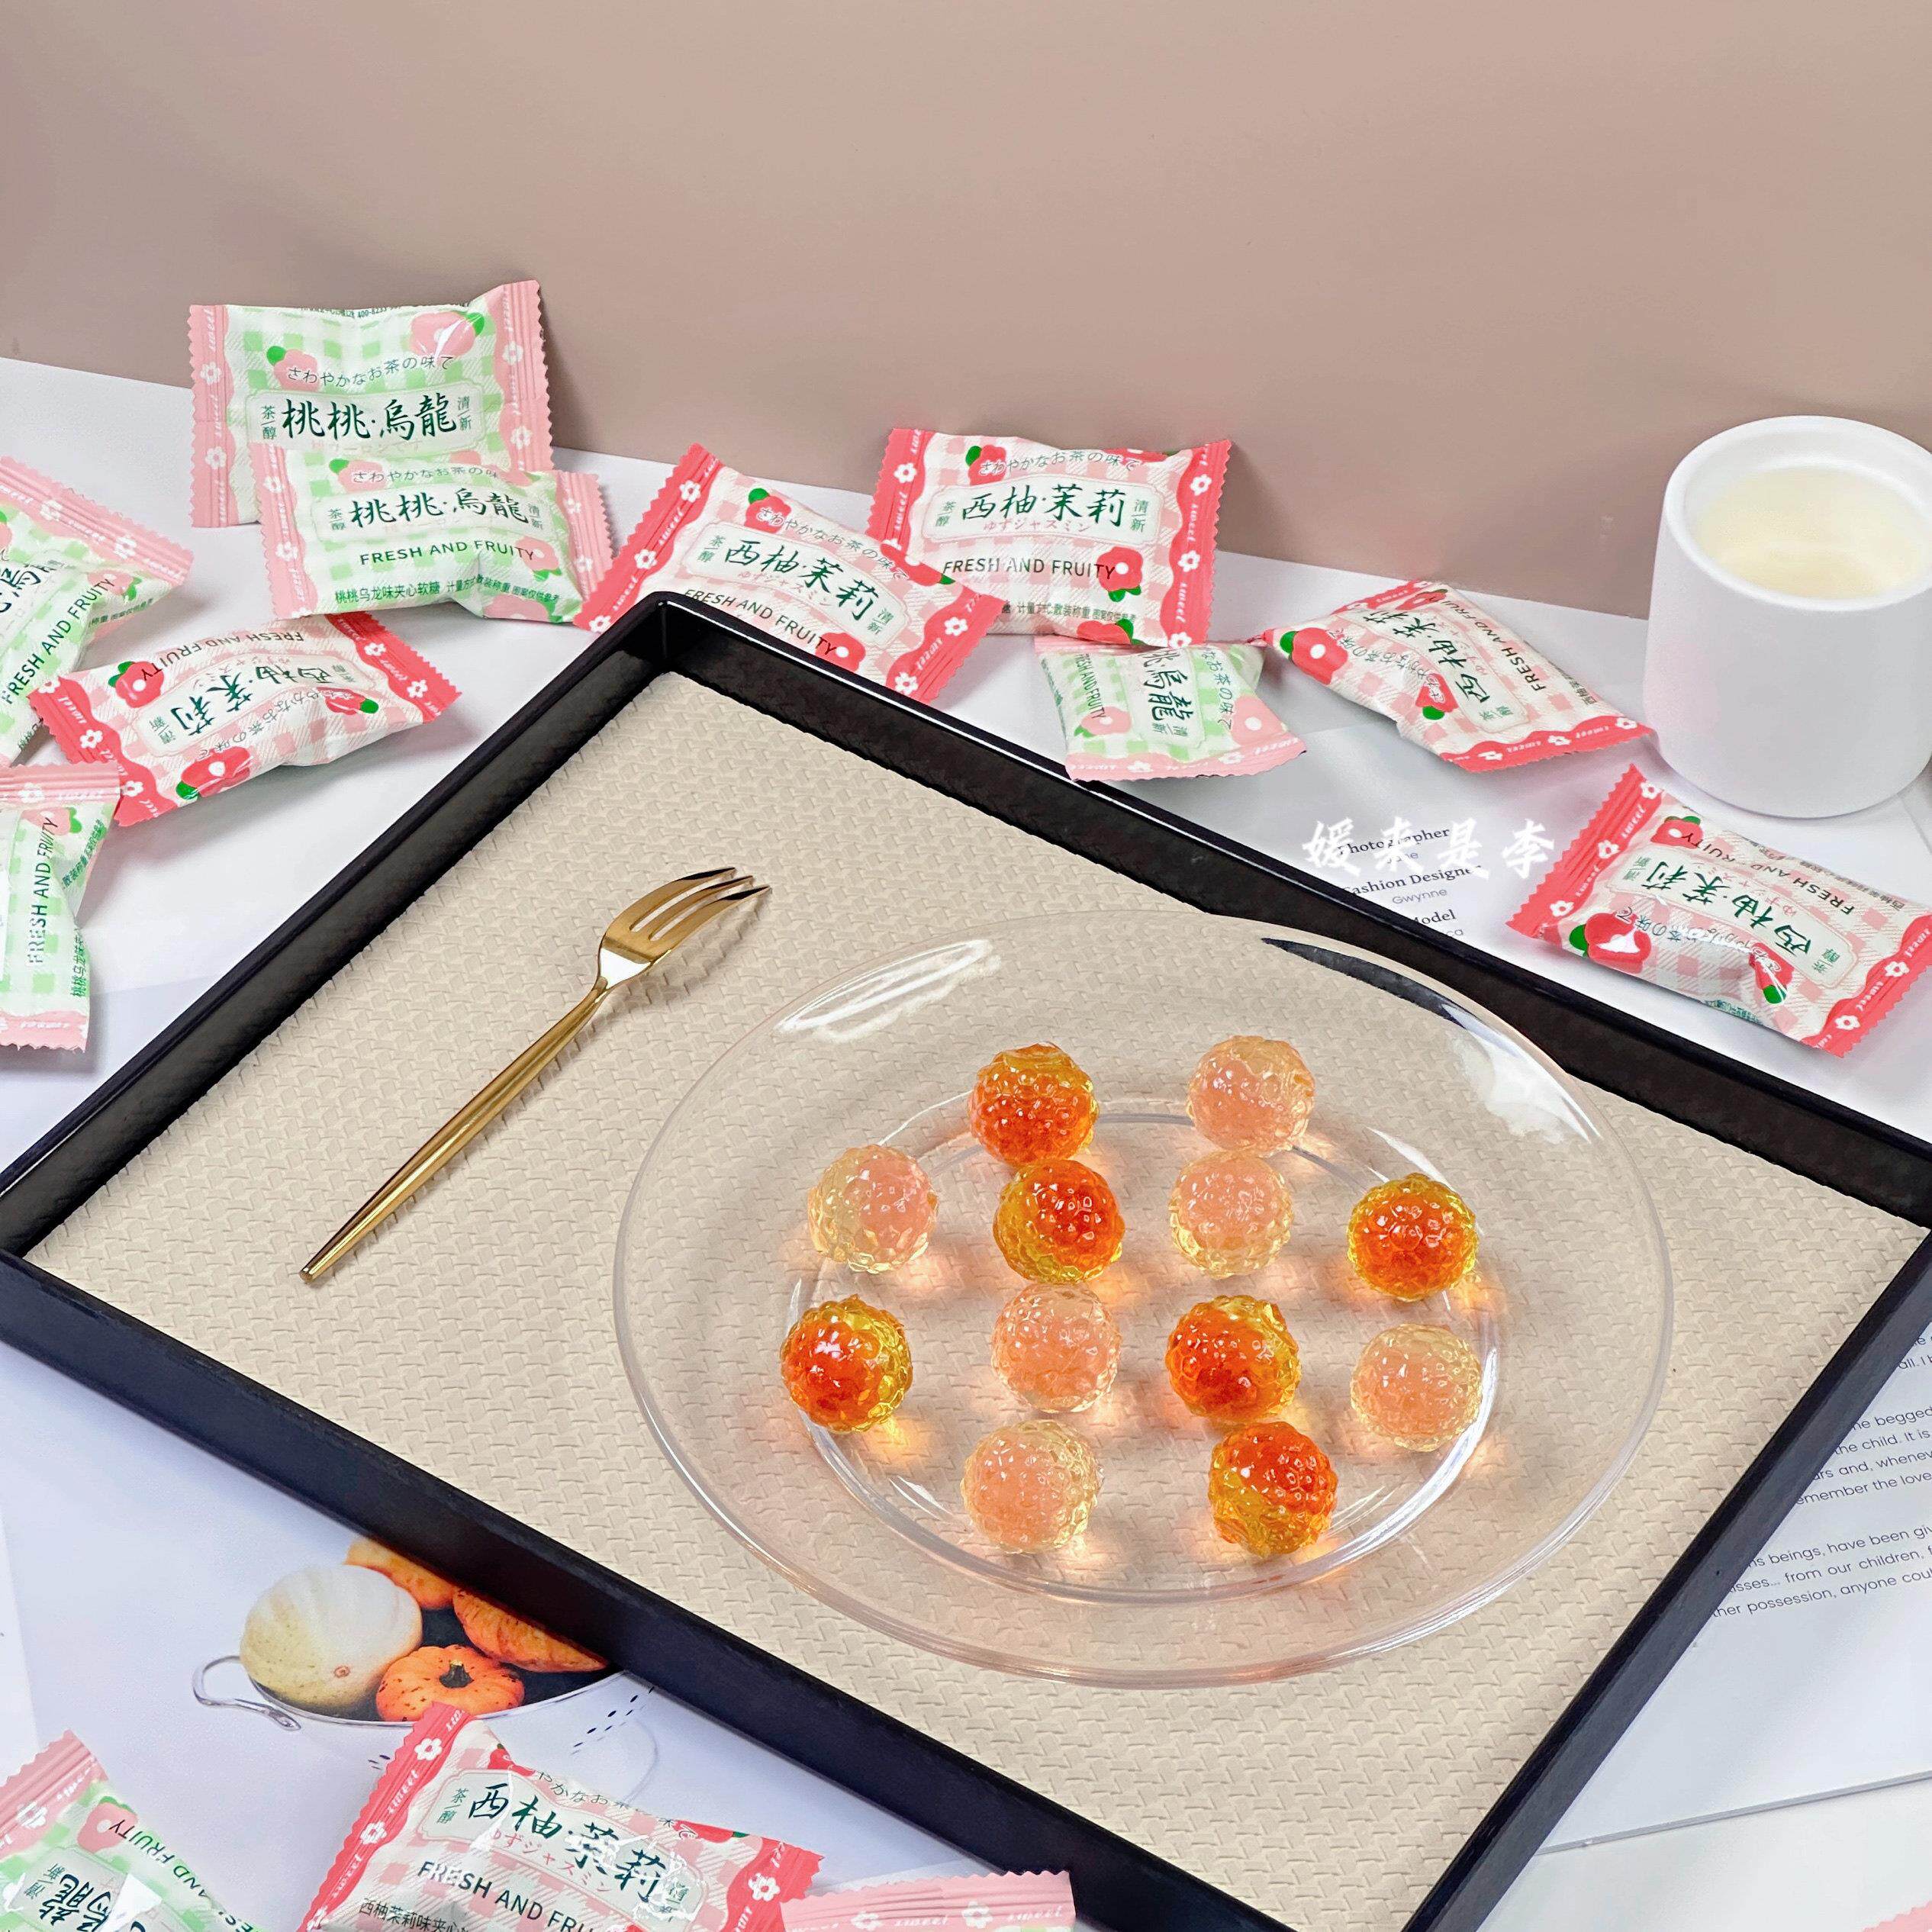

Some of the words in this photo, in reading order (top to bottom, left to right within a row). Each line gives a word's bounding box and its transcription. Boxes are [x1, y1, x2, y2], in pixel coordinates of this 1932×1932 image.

[658, 507, 685, 546] sweet
[359, 546, 423, 565] FRESH
[429, 541, 468, 555] AND
[475, 540, 534, 561] FRUITY
[942, 557, 1000, 575] FRESH
[1006, 558, 1045, 573] AND
[1051, 560, 1117, 581] FRUITY
[249, 631, 305, 642] FRESH
[685, 589, 738, 607] FRESH
[736, 599, 778, 620] AND
[774, 614, 837, 655] FRUITY
[1474, 620, 1507, 644] AND
[2, 653, 45, 705] FRESH
[40, 620, 72, 656] AND
[67, 577, 115, 622] FRUITY
[206, 636, 241, 649] AND
[140, 642, 202, 683] FRUITY
[1500, 647, 1547, 692] FRESH
[1080, 671, 1096, 691] AND
[57, 696, 88, 724] sweet
[1084, 688, 1107, 720] FRUITY
[36, 816, 59, 859] FRUITY
[1621, 803, 1646, 839] sweet
[1682, 832, 1740, 864] RUITY
[33, 858, 51, 899] AND
[1750, 863, 1792, 878] AND
[1392, 887, 1448, 905] Gwynne
[1792, 877, 1855, 916] FRESH
[27, 903, 47, 964] FRESH
[1862, 1435, 1902, 1450] child.
[1904, 1431, 1916, 1443] It
[1918, 1428, 1931, 1440] is
[1872, 1477, 1898, 1491] the
[1768, 1545, 1826, 1564] beings,
[1827, 1538, 1866, 1554] have
[1869, 1530, 1910, 1546] been
[1784, 1567, 1823, 1584] from
[1827, 1562, 1852, 1576] our
[1747, 1587, 1837, 1615] possession,
[1840, 1576, 1898, 1597] anyone
[387, 1768, 420, 1815] sweet
[108, 1819, 175, 1865] FRUITY
[332, 1853, 362, 1898] sweet
[418, 1860, 494, 1899] FRESH
[494, 1889, 543, 1921] AND
[1006, 1906, 1063, 1924] sweet
